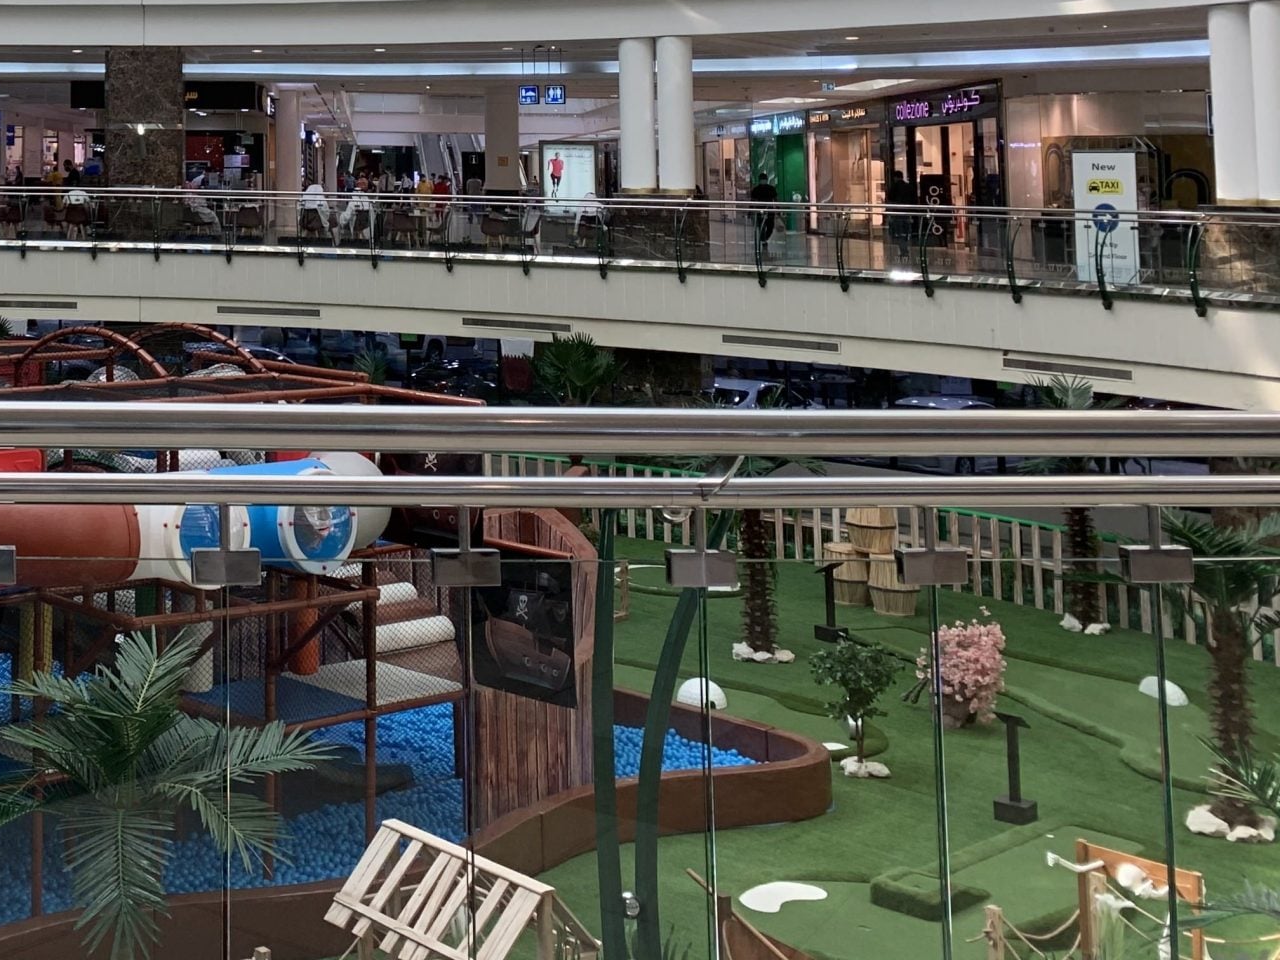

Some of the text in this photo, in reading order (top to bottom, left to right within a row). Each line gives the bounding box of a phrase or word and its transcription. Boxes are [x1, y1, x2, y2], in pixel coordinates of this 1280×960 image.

[895, 100, 929, 120] collezione
[1091, 163, 1116, 171] New
[1099, 180, 1119, 190] TAXI
